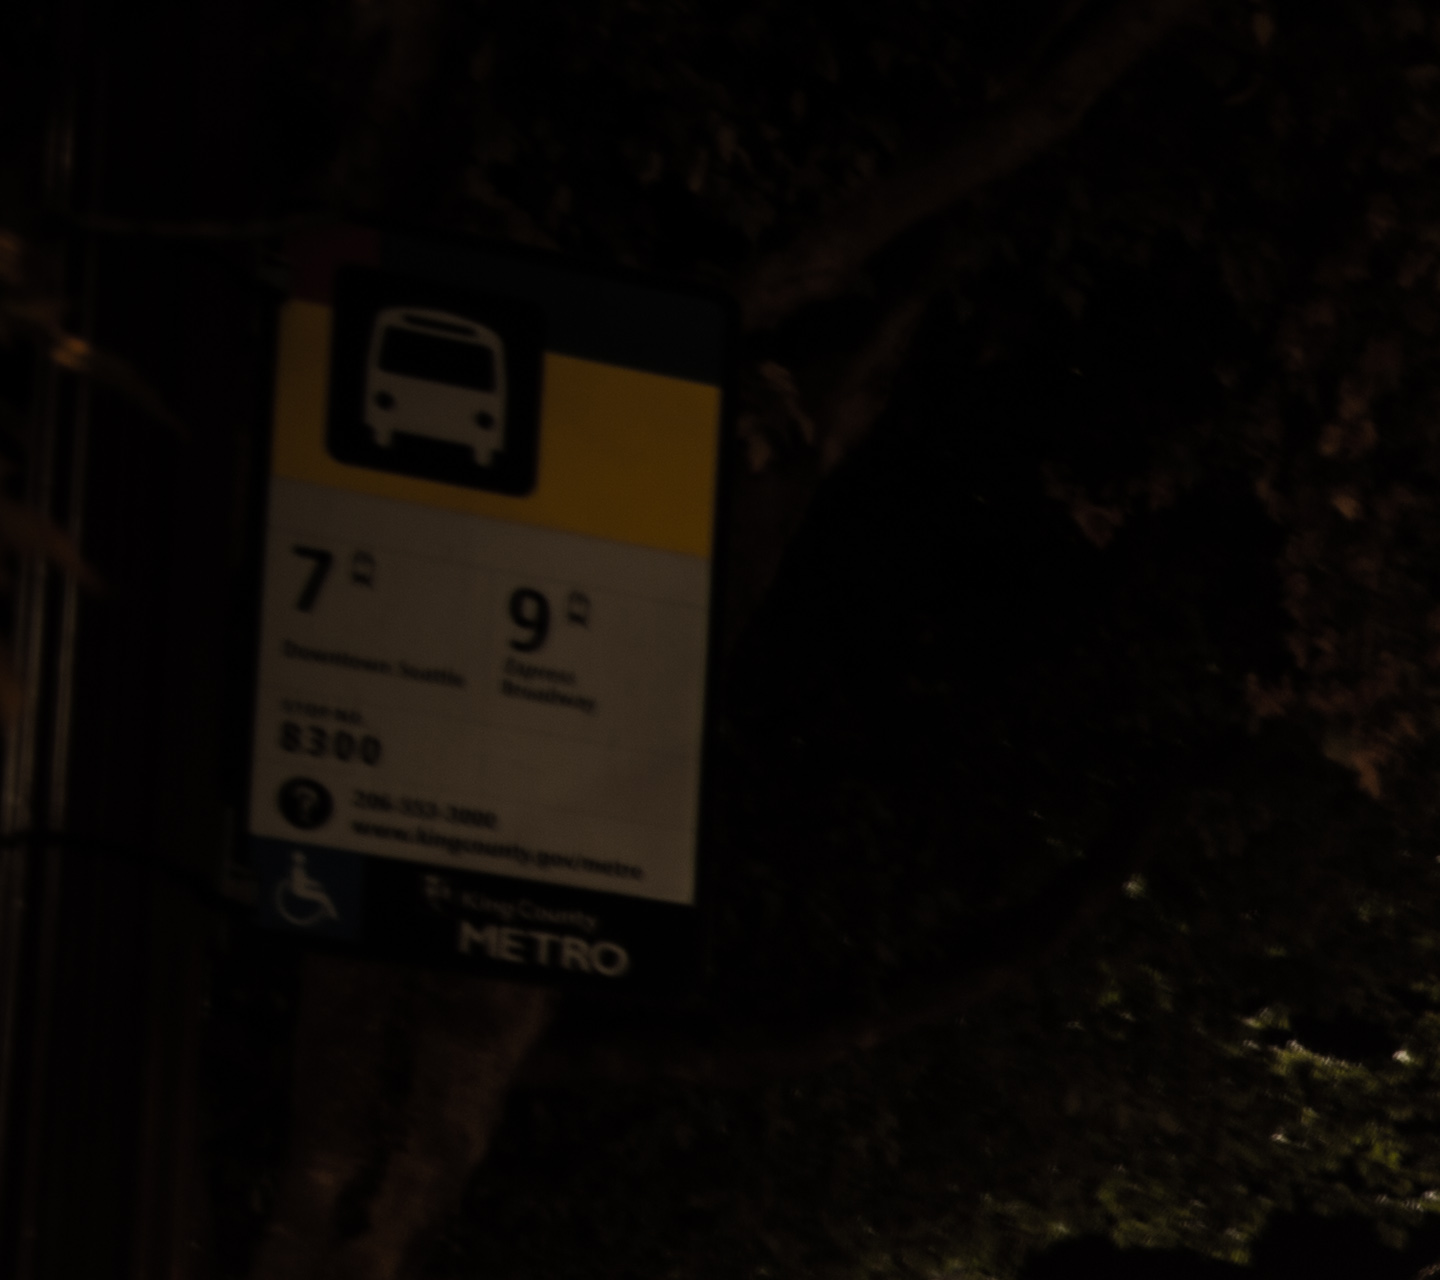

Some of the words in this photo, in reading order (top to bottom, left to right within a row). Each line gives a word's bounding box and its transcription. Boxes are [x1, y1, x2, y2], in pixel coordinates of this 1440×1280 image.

[293, 544, 334, 614] 7
[509, 586, 552, 653] 9
[280, 720, 383, 767] 8300
[460, 888, 517, 922] King
[516, 897, 600, 933] County
[456, 920, 632, 979] METRO
